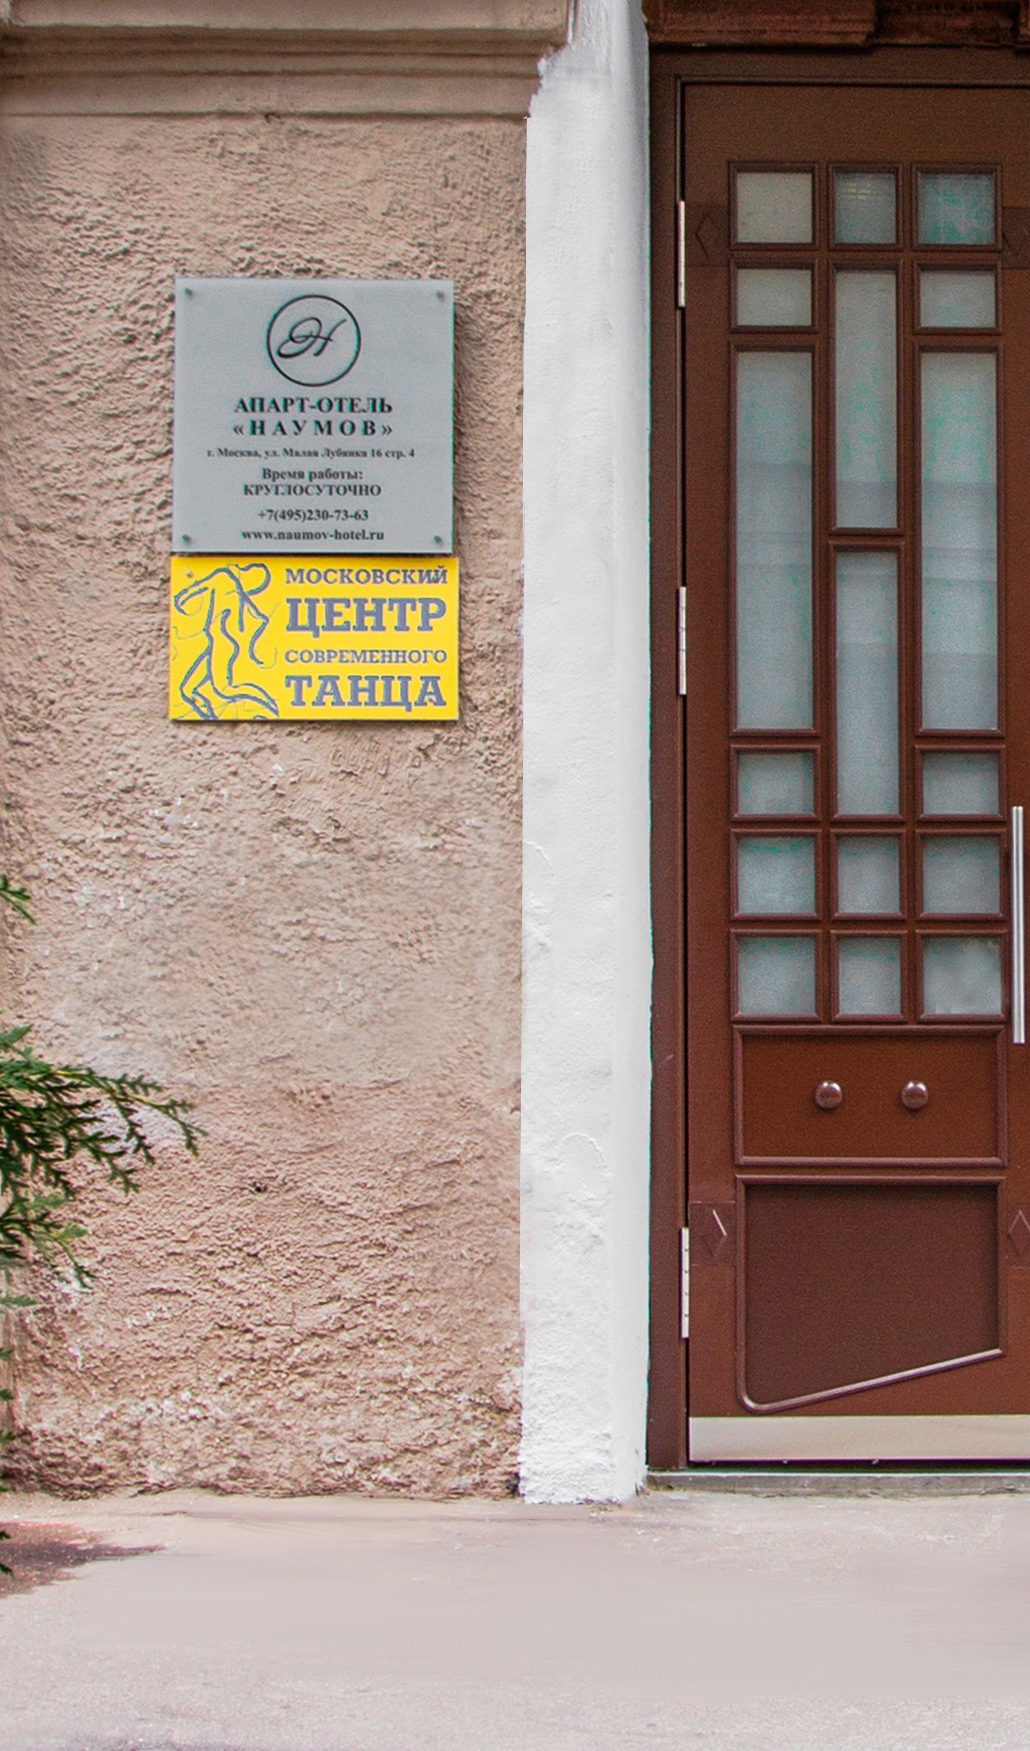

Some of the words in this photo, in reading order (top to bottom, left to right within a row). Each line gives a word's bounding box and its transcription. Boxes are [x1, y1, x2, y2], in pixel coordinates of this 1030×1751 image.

[234, 397, 393, 414] АПАРТ-ОТЕЛЬ
[233, 420, 393, 436] «НАУМОВ»
[207, 450, 215, 458] г.
[217, 449, 262, 459] Москва,
[264, 450, 280, 459] ул.
[283, 449, 319, 458] Малая
[321, 449, 368, 460] Лубянка
[371, 449, 382, 458] 16
[384, 450, 406, 460] стр.
[408, 449, 415, 458] 4
[262, 468, 305, 482] Время
[308, 467, 363, 482] работы:
[243, 484, 382, 497] КРУГЛОСУТОЧНО
[257, 509, 369, 523] +7(495)230-73-63
[241, 529, 385, 541] www.naumov-hotel.ru
[285, 565, 448, 585] МОСКОВСКИЙ
[286, 597, 447, 638] ЦЕНТР
[284, 649, 447, 664] СОВРЕМЕННОГО
[285, 675, 447, 712] ТАНЦА
